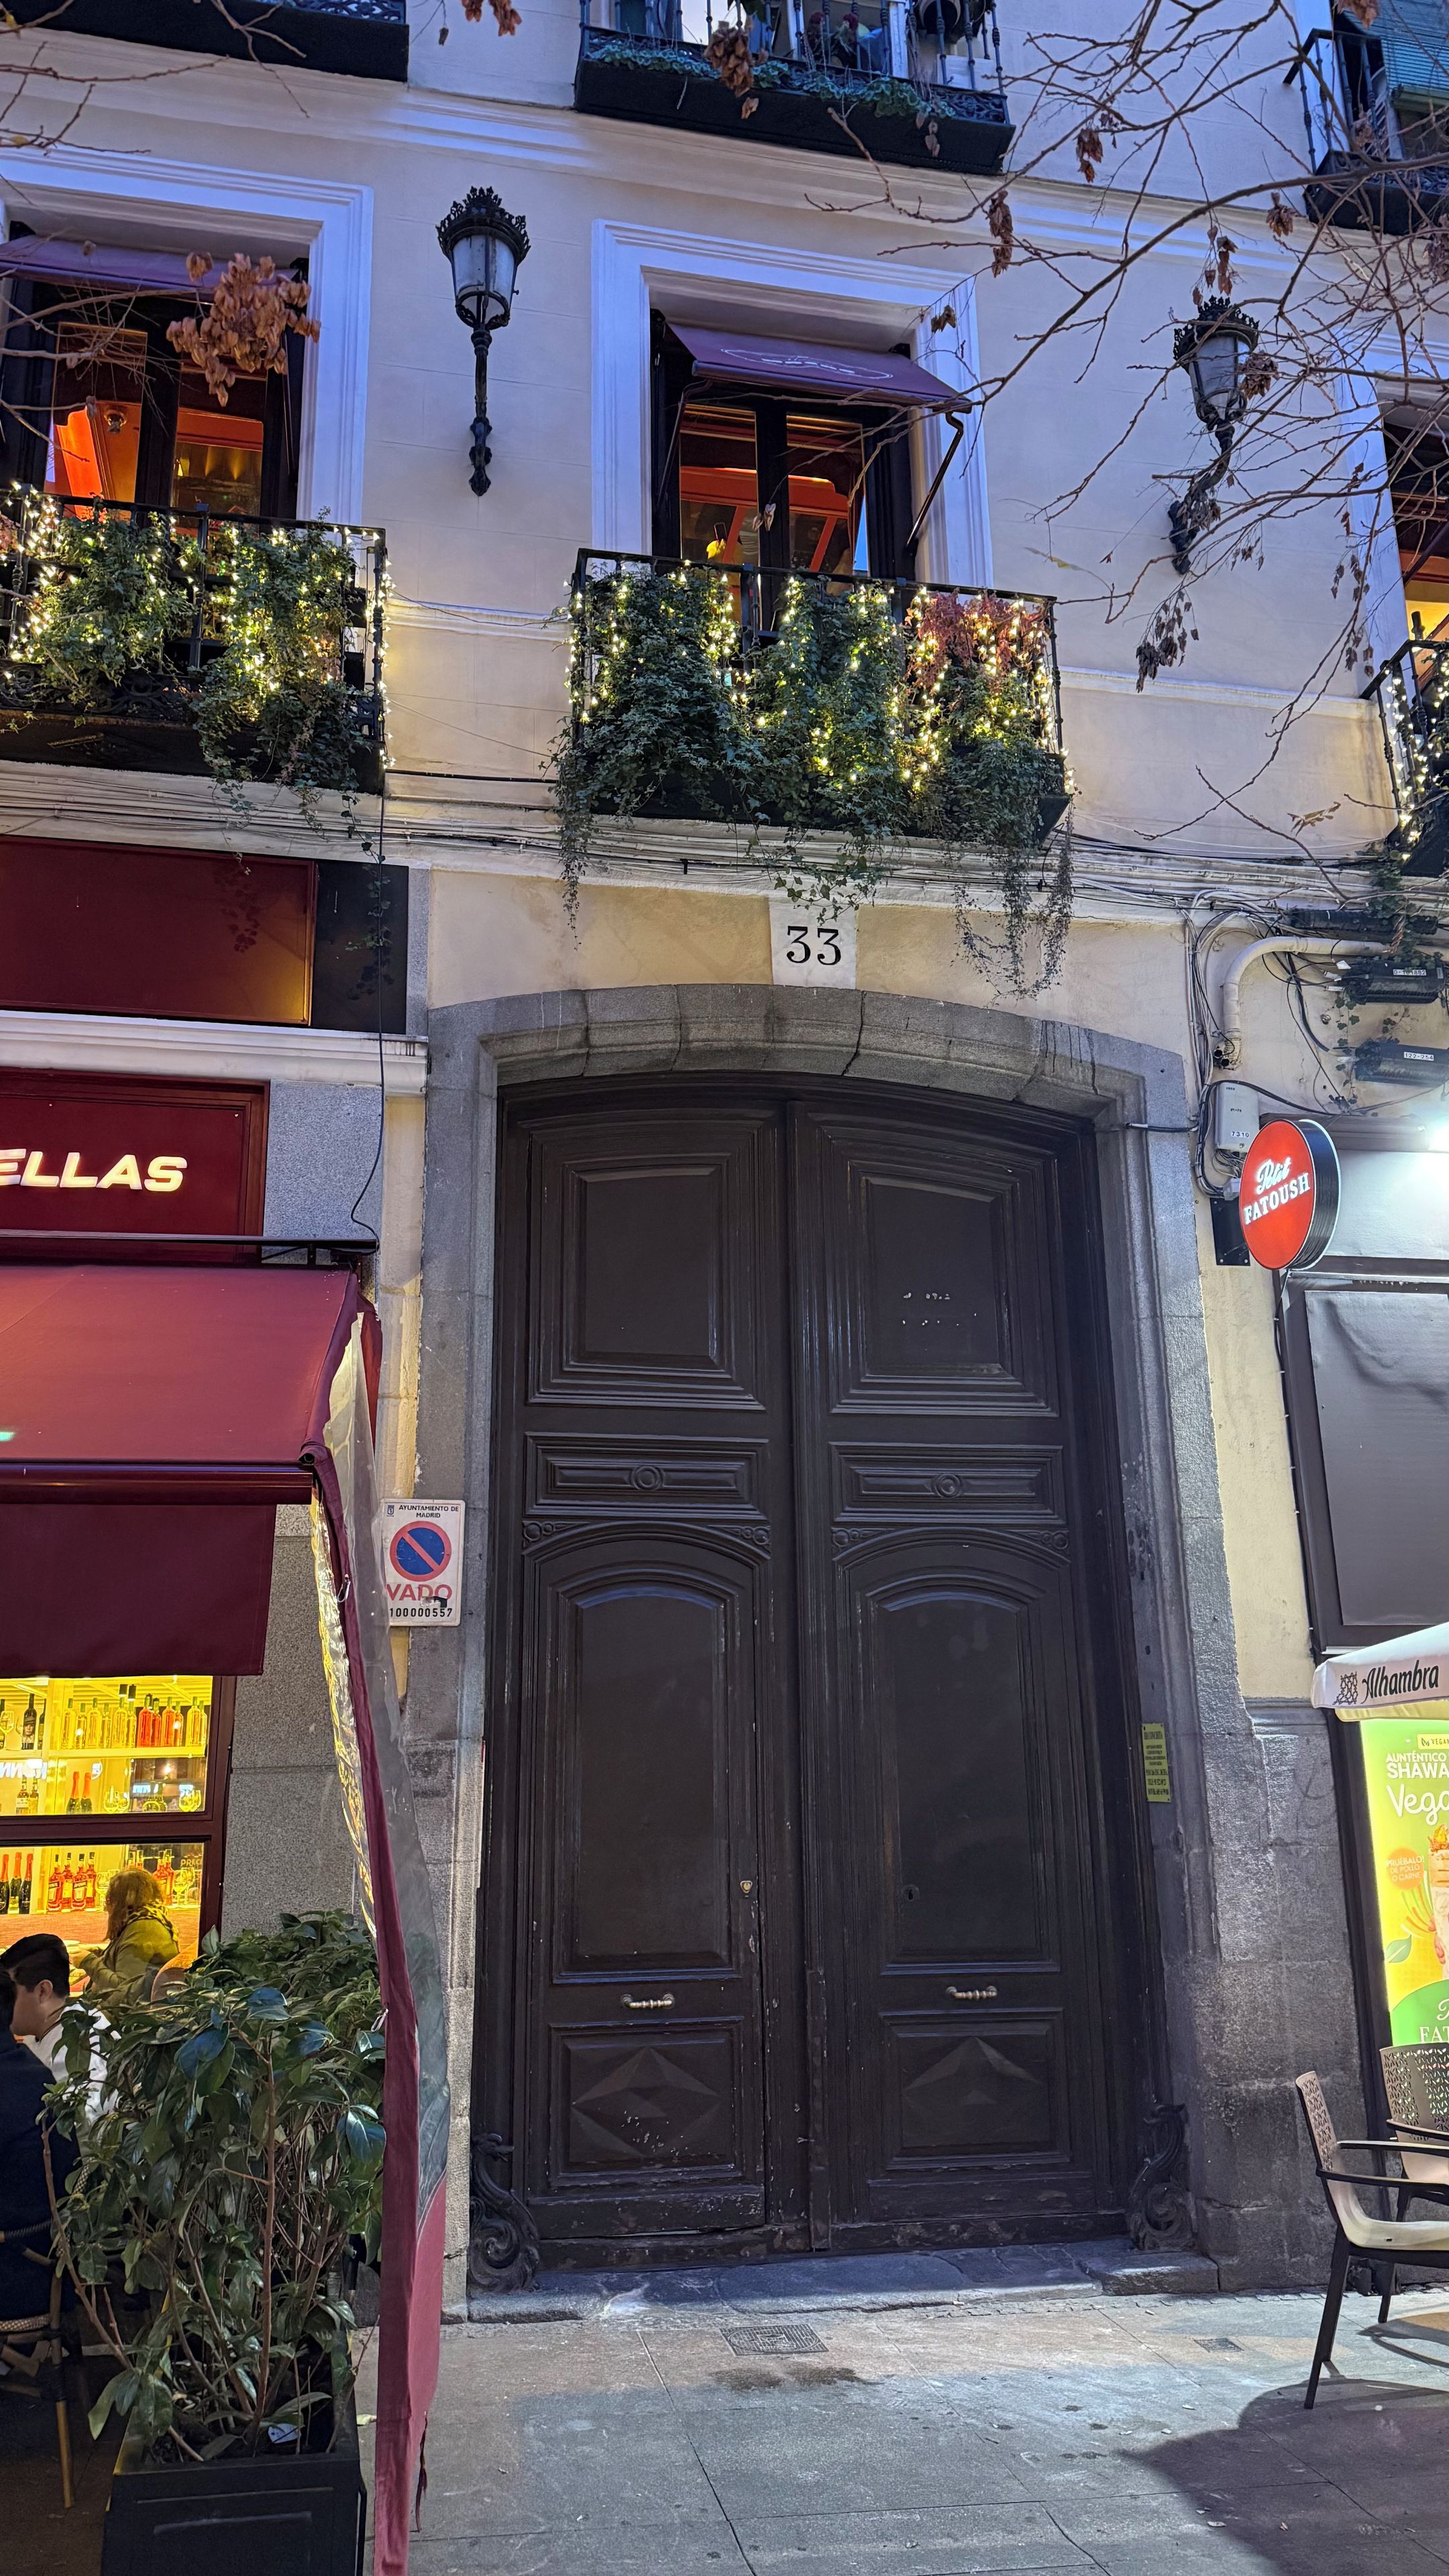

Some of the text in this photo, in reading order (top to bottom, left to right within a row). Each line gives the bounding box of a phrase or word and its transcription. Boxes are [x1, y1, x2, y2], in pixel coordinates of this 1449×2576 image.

[786, 925, 841, 966] 33
[1244, 1172, 1311, 1225] FATOUSH
[386, 1583, 453, 1601] VADO
[390, 1607, 453, 1617] 100000557
[1360, 1660, 1439, 1704] Alhambra
[1385, 1750, 1447, 1763] AUNTÉNTICO
